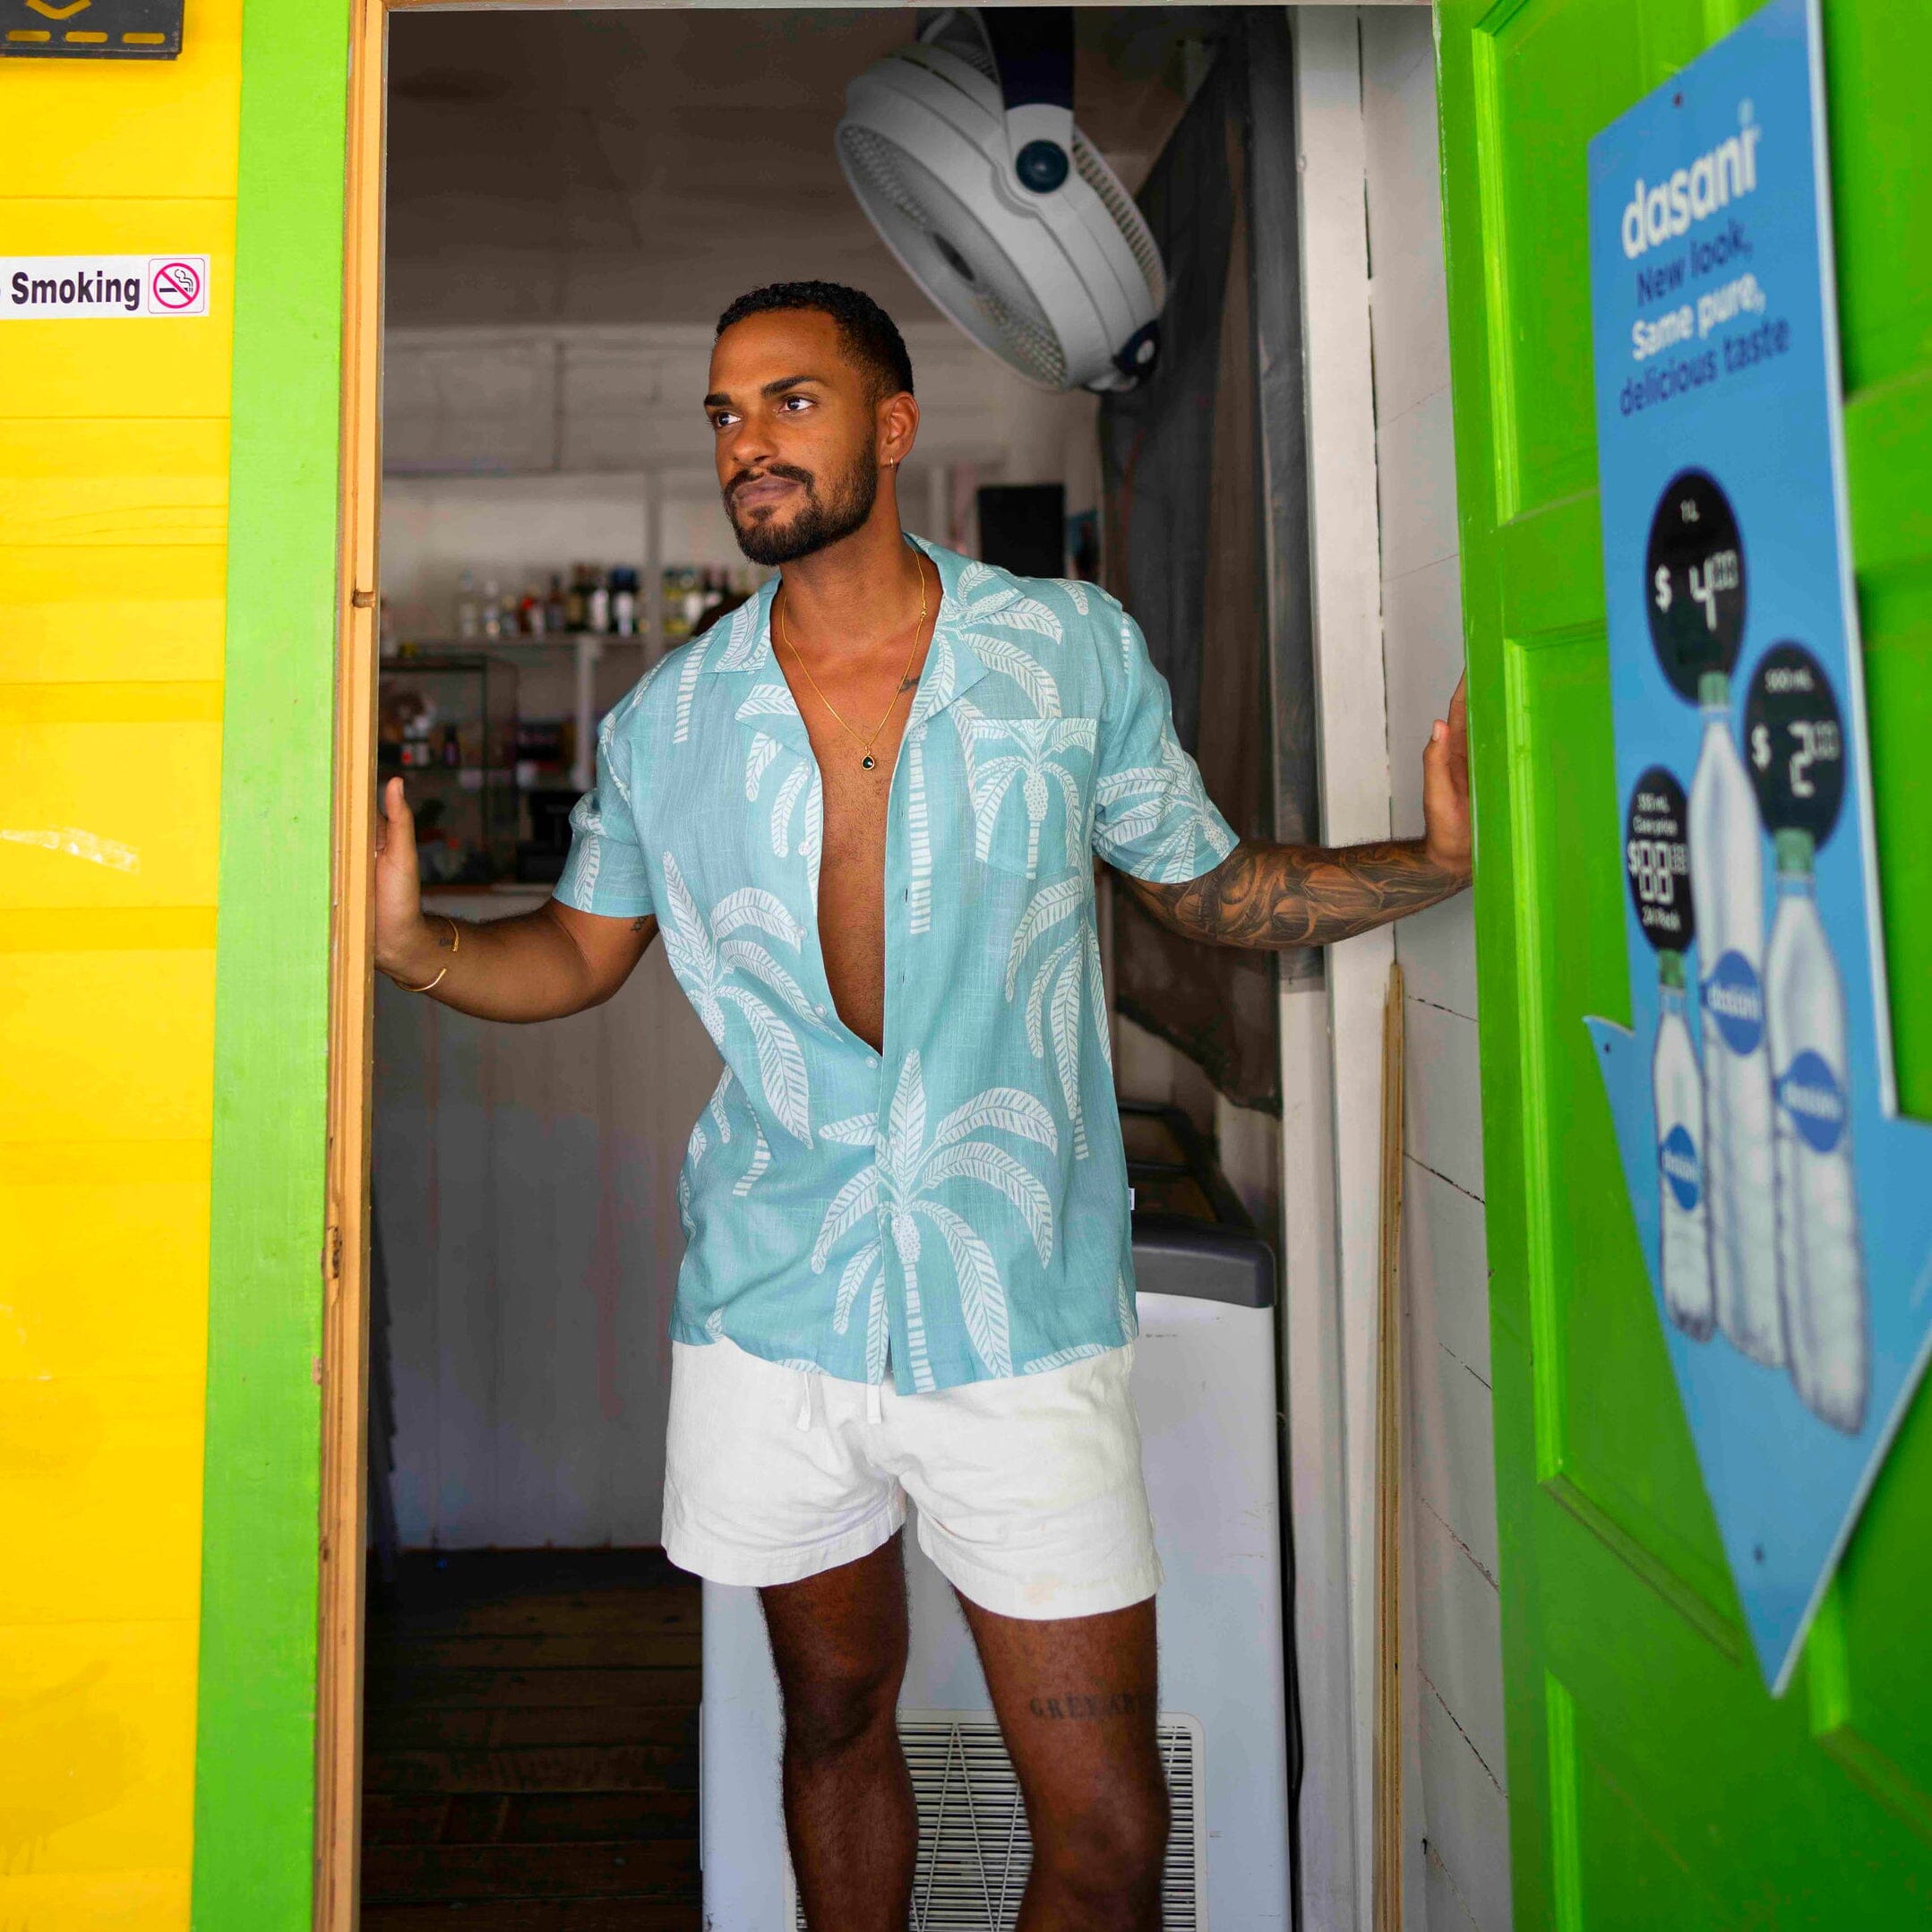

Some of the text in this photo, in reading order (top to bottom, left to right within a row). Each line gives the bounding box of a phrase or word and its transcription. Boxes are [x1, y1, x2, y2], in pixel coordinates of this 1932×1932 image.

[1622, 99, 1756, 259] dasani
[12, 270, 140, 311] Smoking
[1636, 218, 1753, 306] New look,
[1631, 273, 1766, 361] Same pure,
[1619, 318, 1790, 416] delicious taste
